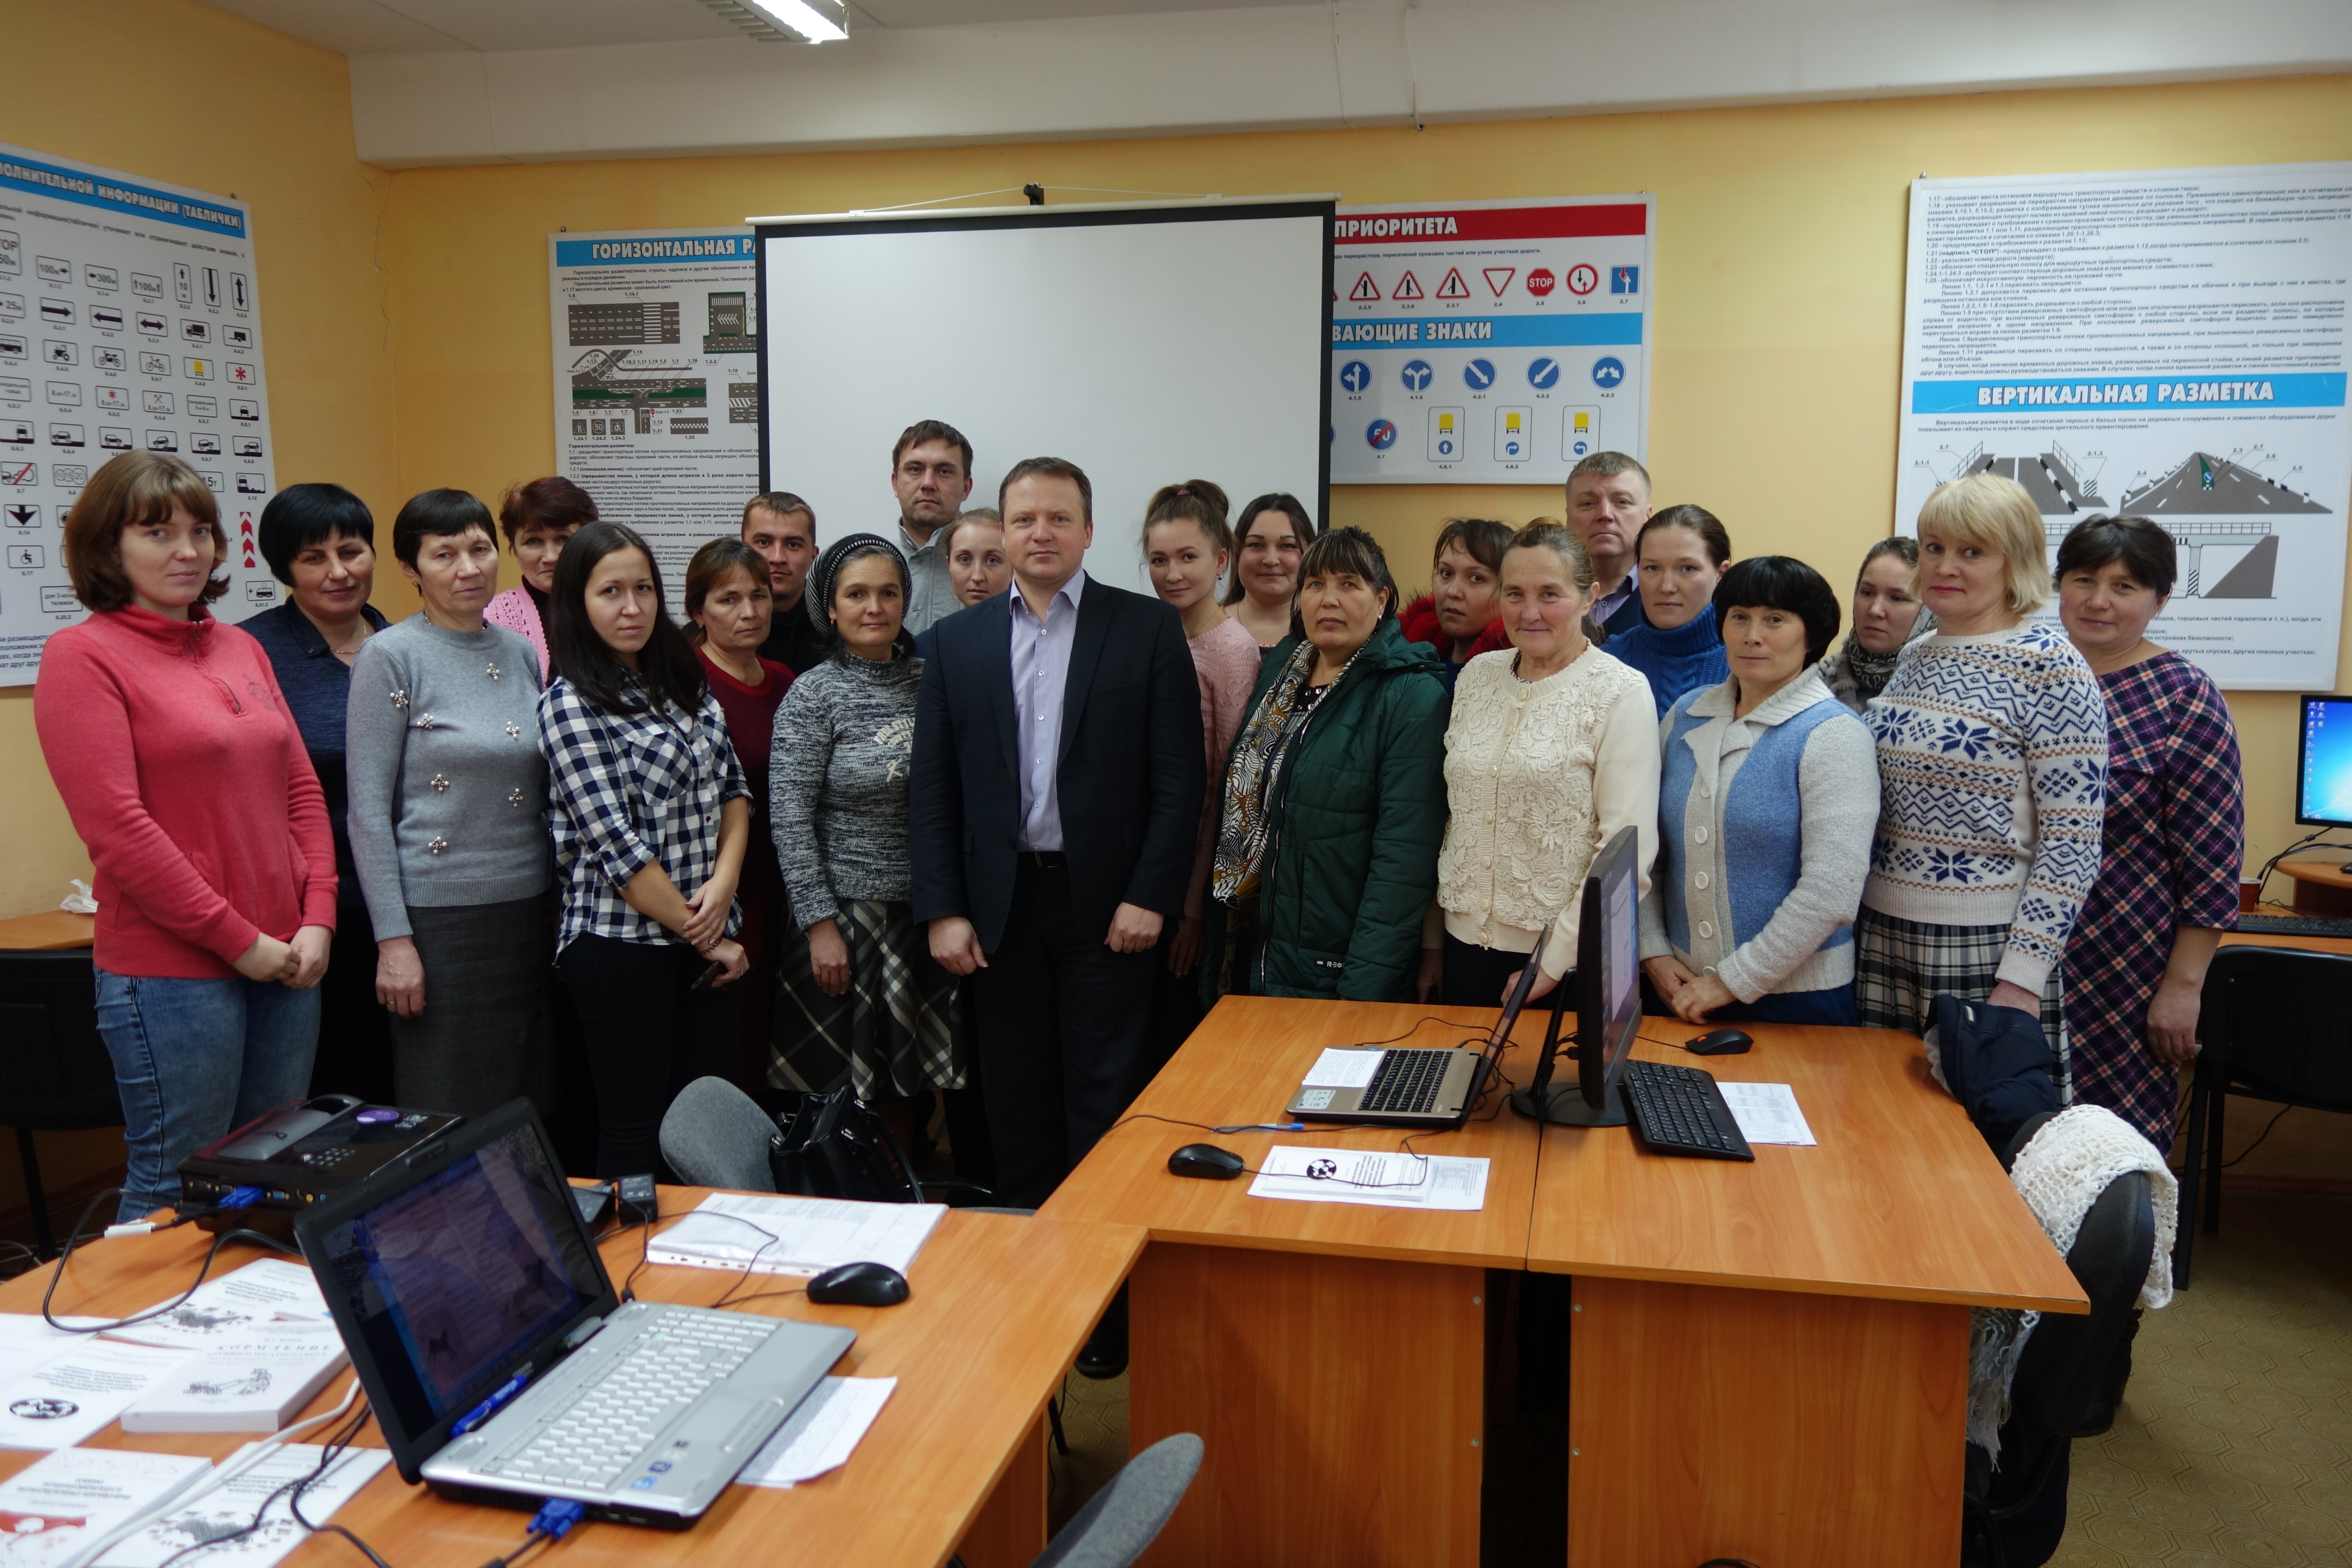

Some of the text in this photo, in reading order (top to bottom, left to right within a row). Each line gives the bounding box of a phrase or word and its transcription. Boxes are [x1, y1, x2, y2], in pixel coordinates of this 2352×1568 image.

[98, 184, 179, 215] ИНФОРМАЦИИ
[183, 203, 242, 231] (ТАБЛИЧКИ)
[1335, 216, 1458, 237] ПРИОРИТЕТА
[592, 239, 735, 259] ГОРИЗОНТАЛЬНАЯ
[179, 282, 188, 291] 10
[1529, 278, 1553, 288] STOP
[1333, 322, 1492, 344] ВАЮЩИЕ ЗНАКИ
[1978, 381, 2274, 405] ВЕРТИКАЛЬНАЯ РАЗМЕТКА
